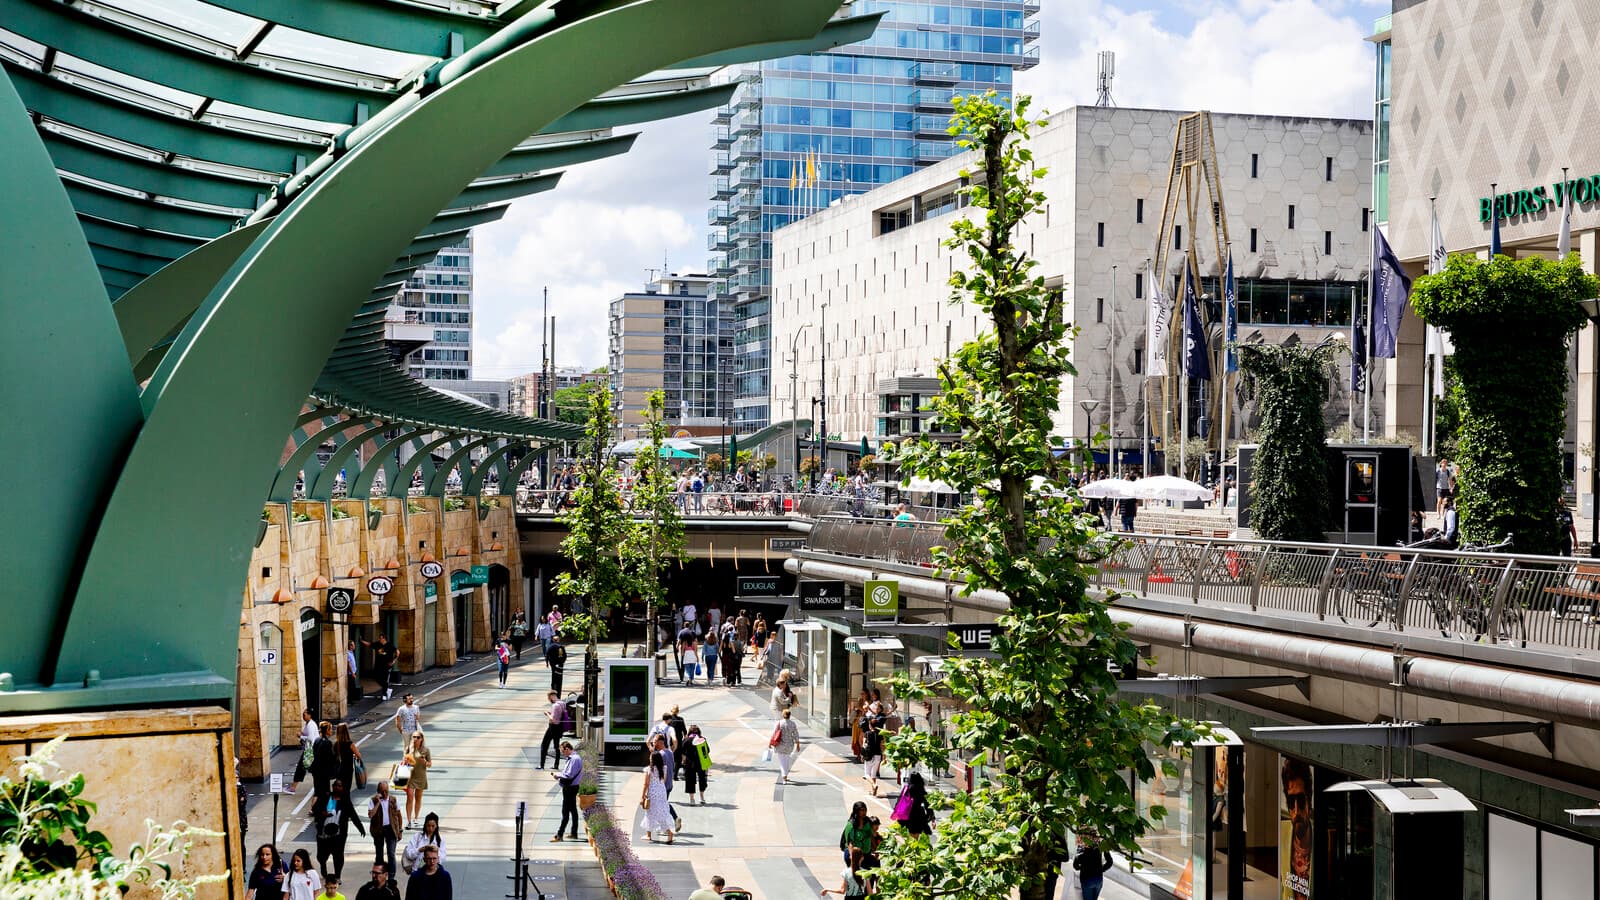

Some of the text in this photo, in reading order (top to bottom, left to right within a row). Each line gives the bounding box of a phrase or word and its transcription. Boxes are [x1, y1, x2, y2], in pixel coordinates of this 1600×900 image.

[424, 565, 439, 575] C&A
[371, 581, 388, 591] C&A
[743, 582, 776, 590] DOUGLAS
[962, 629, 992, 644] WE
[267, 652, 275, 663] P
[1284, 879, 1310, 897] COLLECTION
